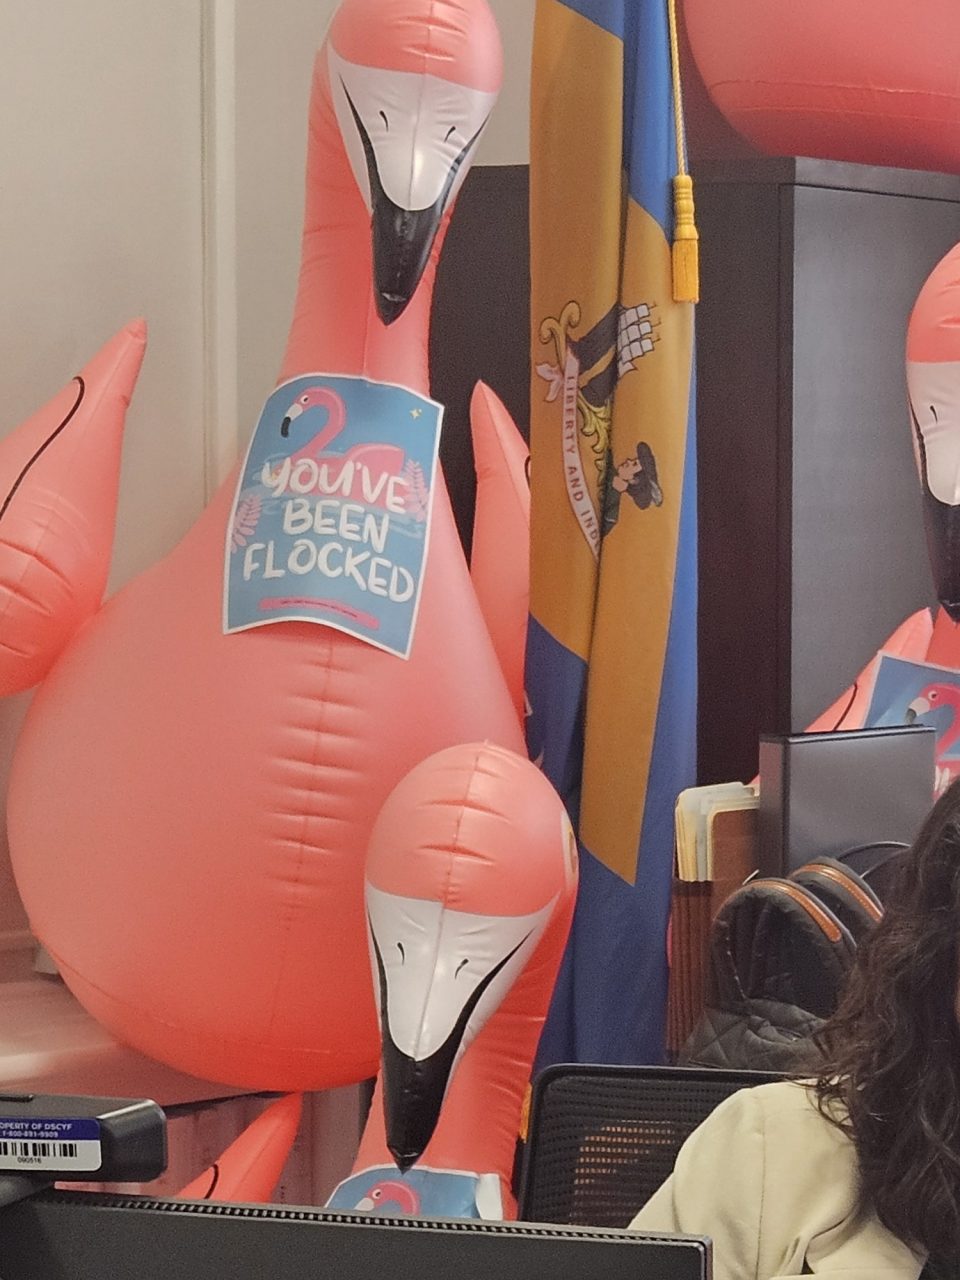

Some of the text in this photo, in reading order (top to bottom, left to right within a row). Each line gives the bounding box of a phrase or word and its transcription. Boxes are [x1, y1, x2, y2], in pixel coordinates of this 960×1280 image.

[564, 376, 576, 454] LIBERTY
[261, 457, 410, 514] YOU'VE
[568, 466, 585, 502] AND
[283, 498, 390, 554] BEEN
[243, 539, 415, 603] FLOCKED
[31, 1122, 42, 1130] OF
[44, 1123, 72, 1131] DSCYF
